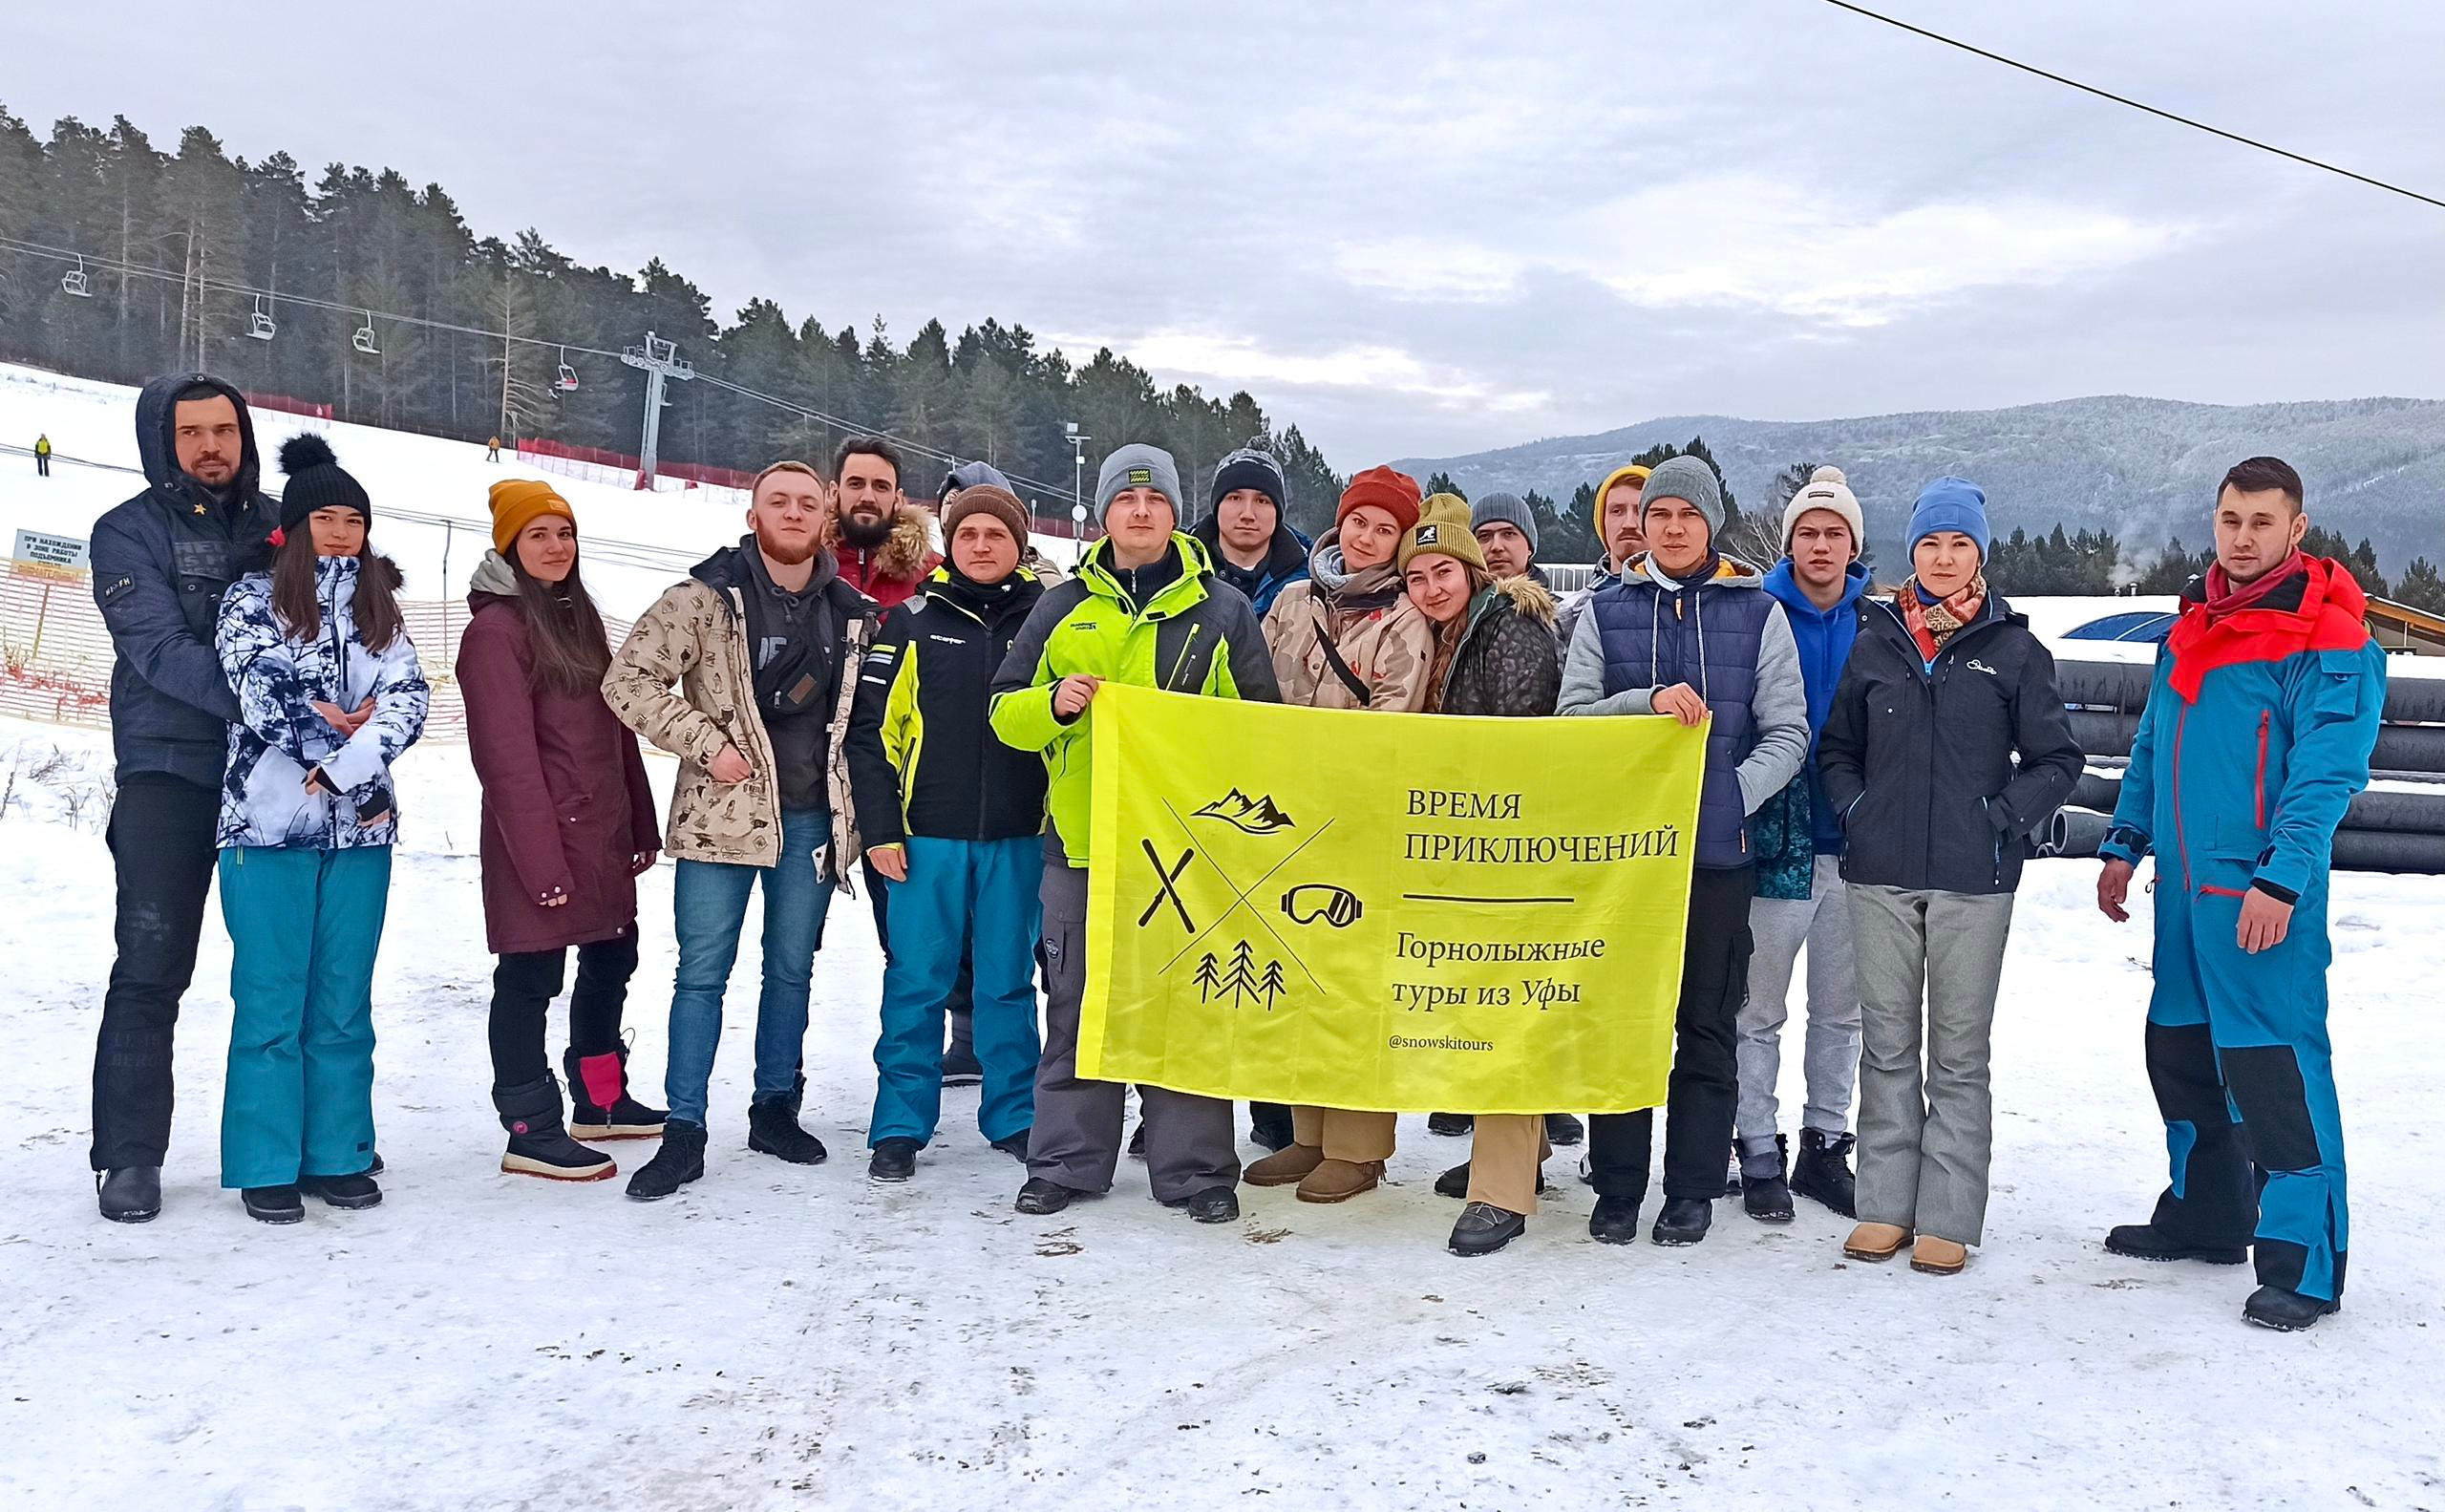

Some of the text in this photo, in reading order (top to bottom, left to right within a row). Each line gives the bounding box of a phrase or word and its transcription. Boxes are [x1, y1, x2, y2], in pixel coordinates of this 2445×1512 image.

[39, 538, 82, 550] НАХОЖДЕНИИ
[52, 547, 78, 557] РАБОТЫ
[1406, 789, 1522, 820] ВРЕМЯ
[1404, 823, 1679, 863] ПРИКЛЮЧЕНИЙ
[1395, 931, 1605, 968] Горнолыжные
[1392, 977, 1581, 1012] туры из Уфы
[1389, 1034, 1494, 1053] @snowskitours
